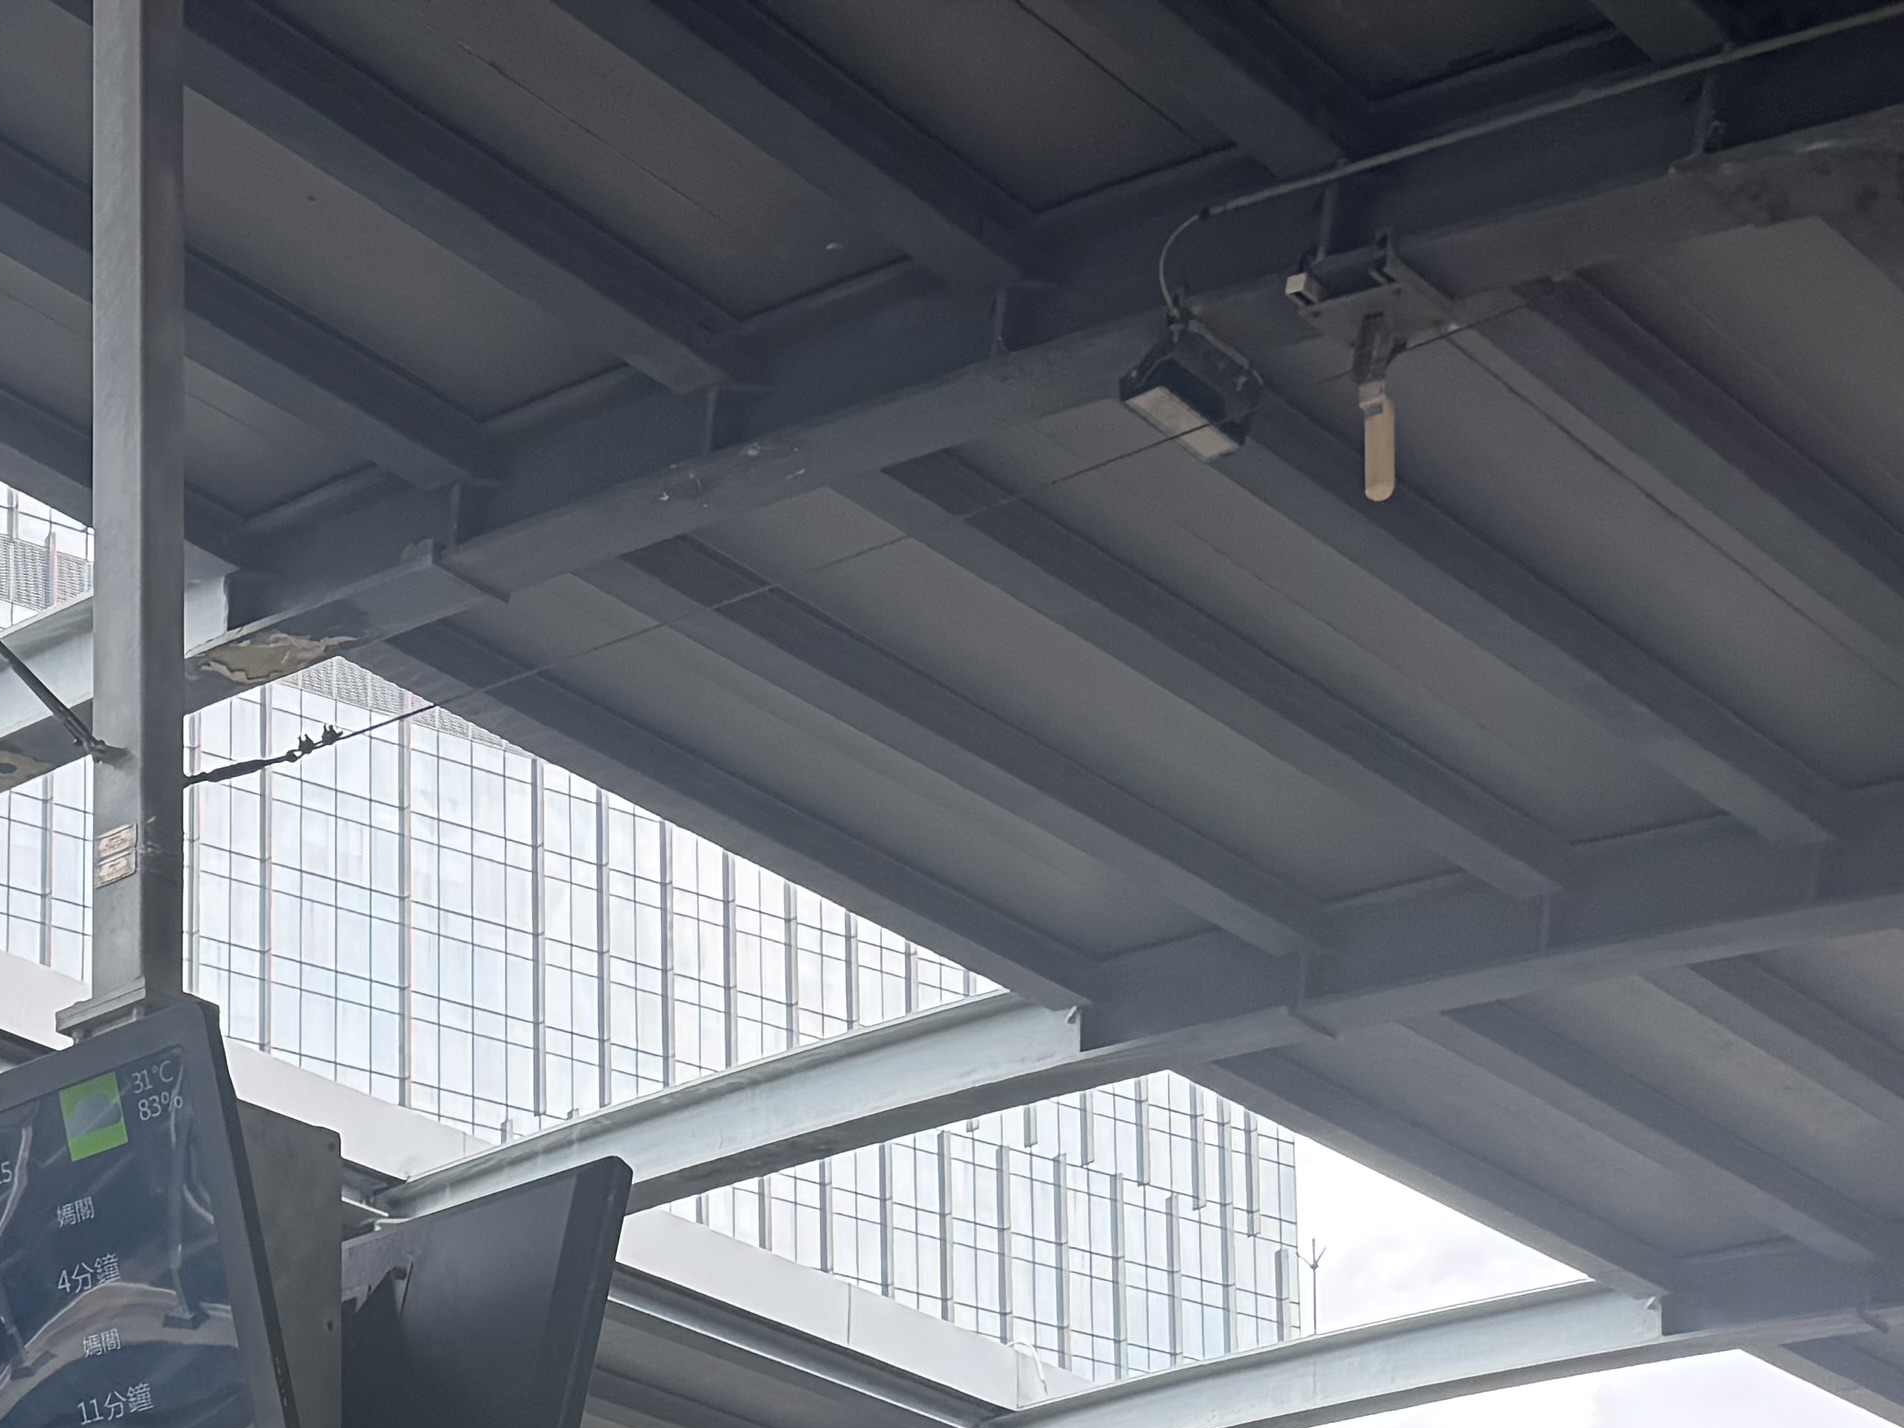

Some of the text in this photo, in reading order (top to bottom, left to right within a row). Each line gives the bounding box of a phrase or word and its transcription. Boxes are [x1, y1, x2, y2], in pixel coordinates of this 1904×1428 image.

[131, 1060, 174, 1094] 31°C
[138, 1091, 183, 1121] 83%
[56, 1196, 95, 1228] 媽閣
[57, 1253, 122, 1294] 4分鐘
[82, 1328, 122, 1358] 媽閣
[77, 1382, 155, 1426] 11分鐘
